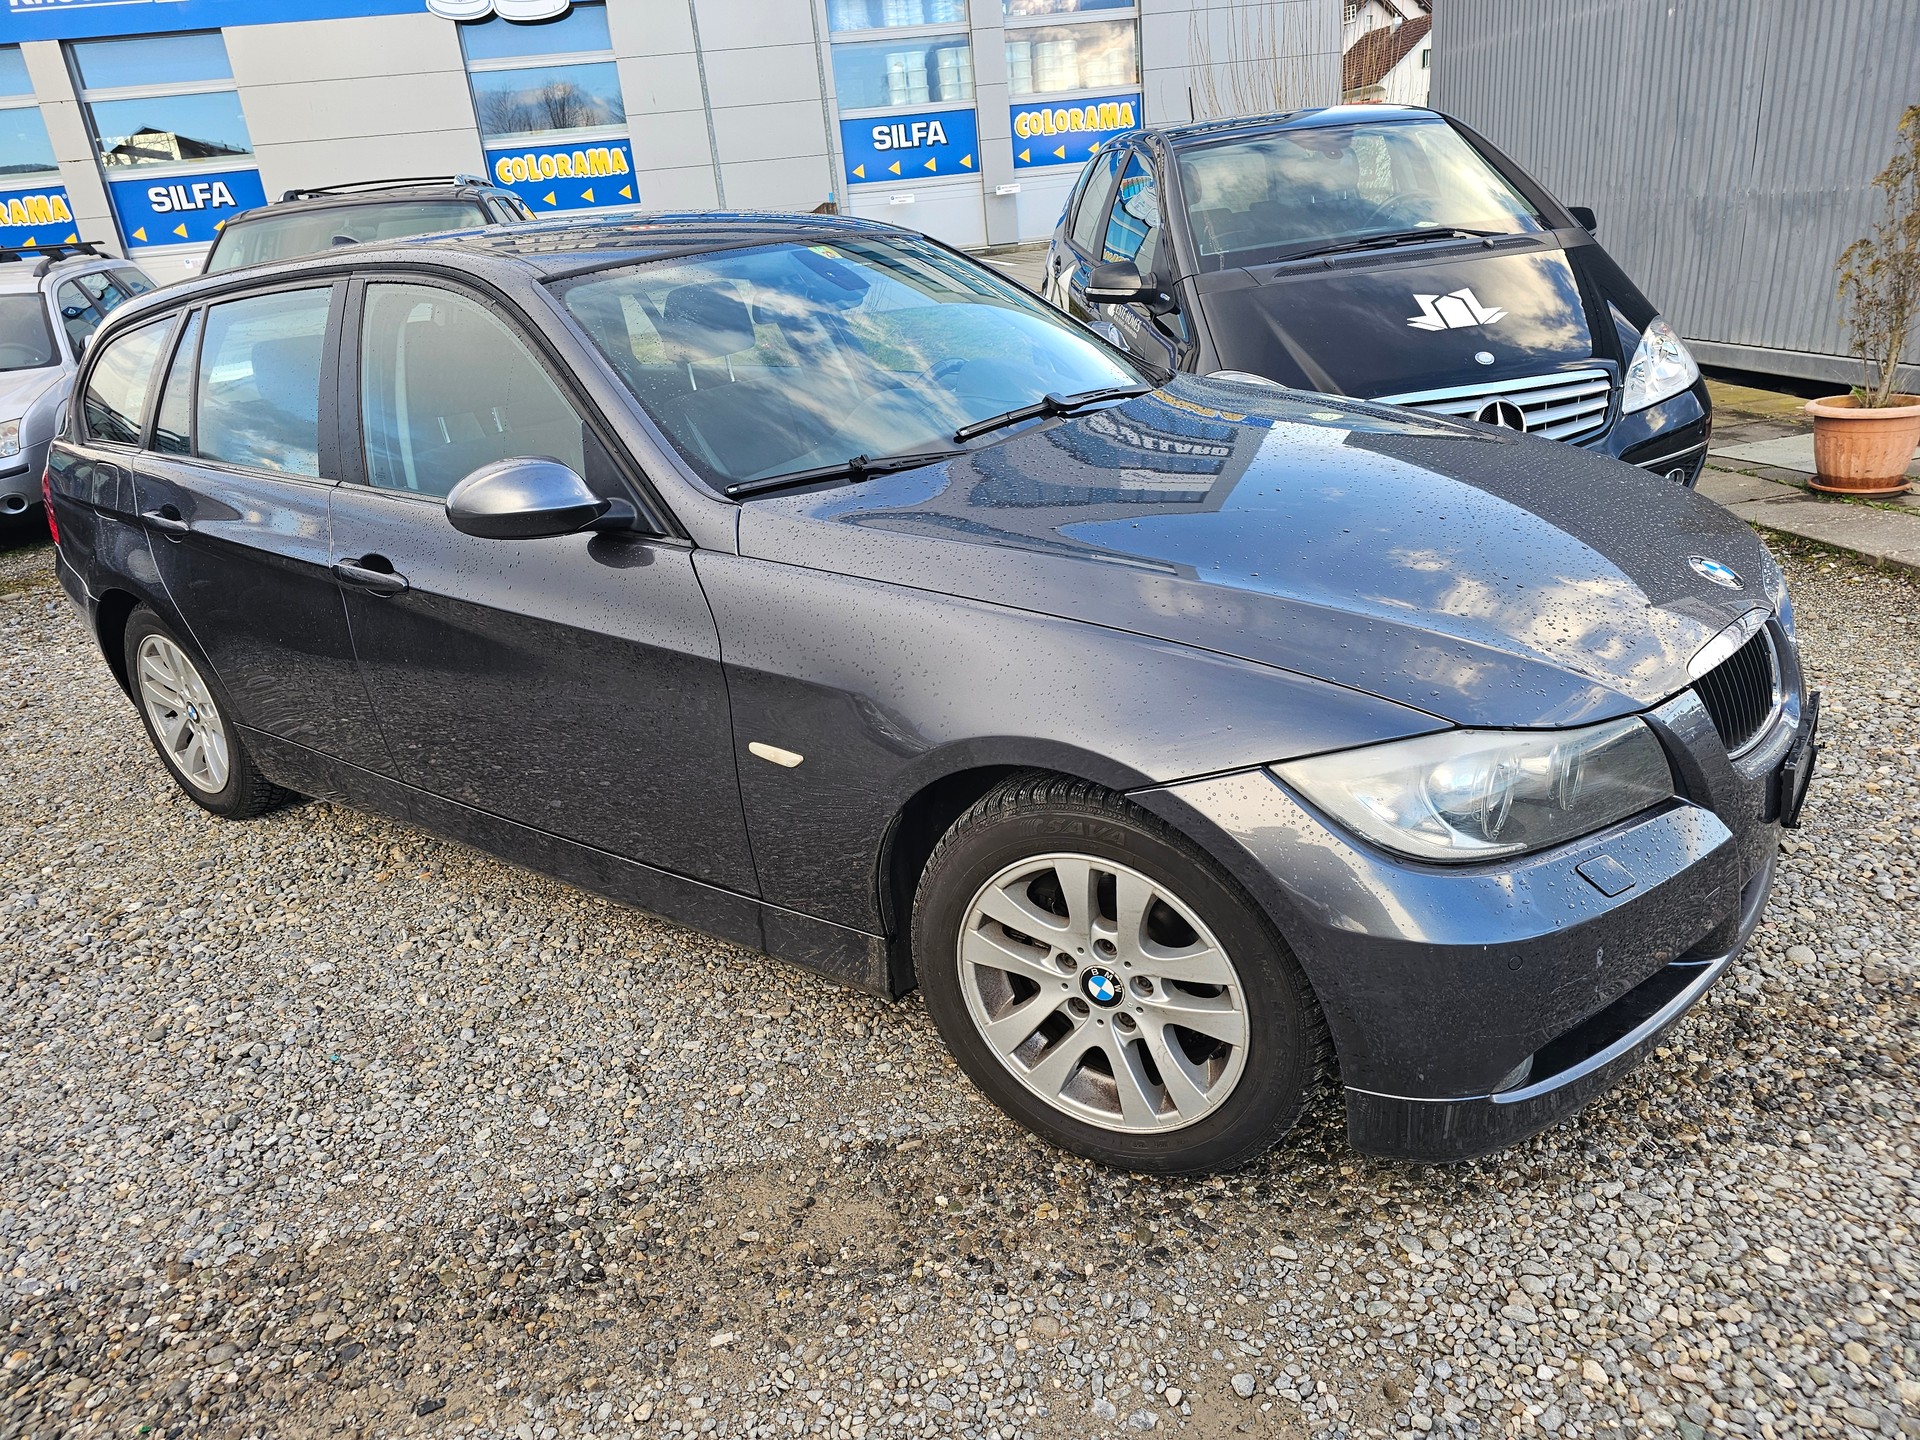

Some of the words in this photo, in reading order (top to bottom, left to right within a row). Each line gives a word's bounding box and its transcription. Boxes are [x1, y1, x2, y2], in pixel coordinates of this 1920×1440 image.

[872, 120, 949, 151] SILFA
[147, 181, 238, 213] SILFA
[1041, 817, 1126, 847] SAVA
[1091, 968, 1122, 993] BMW
